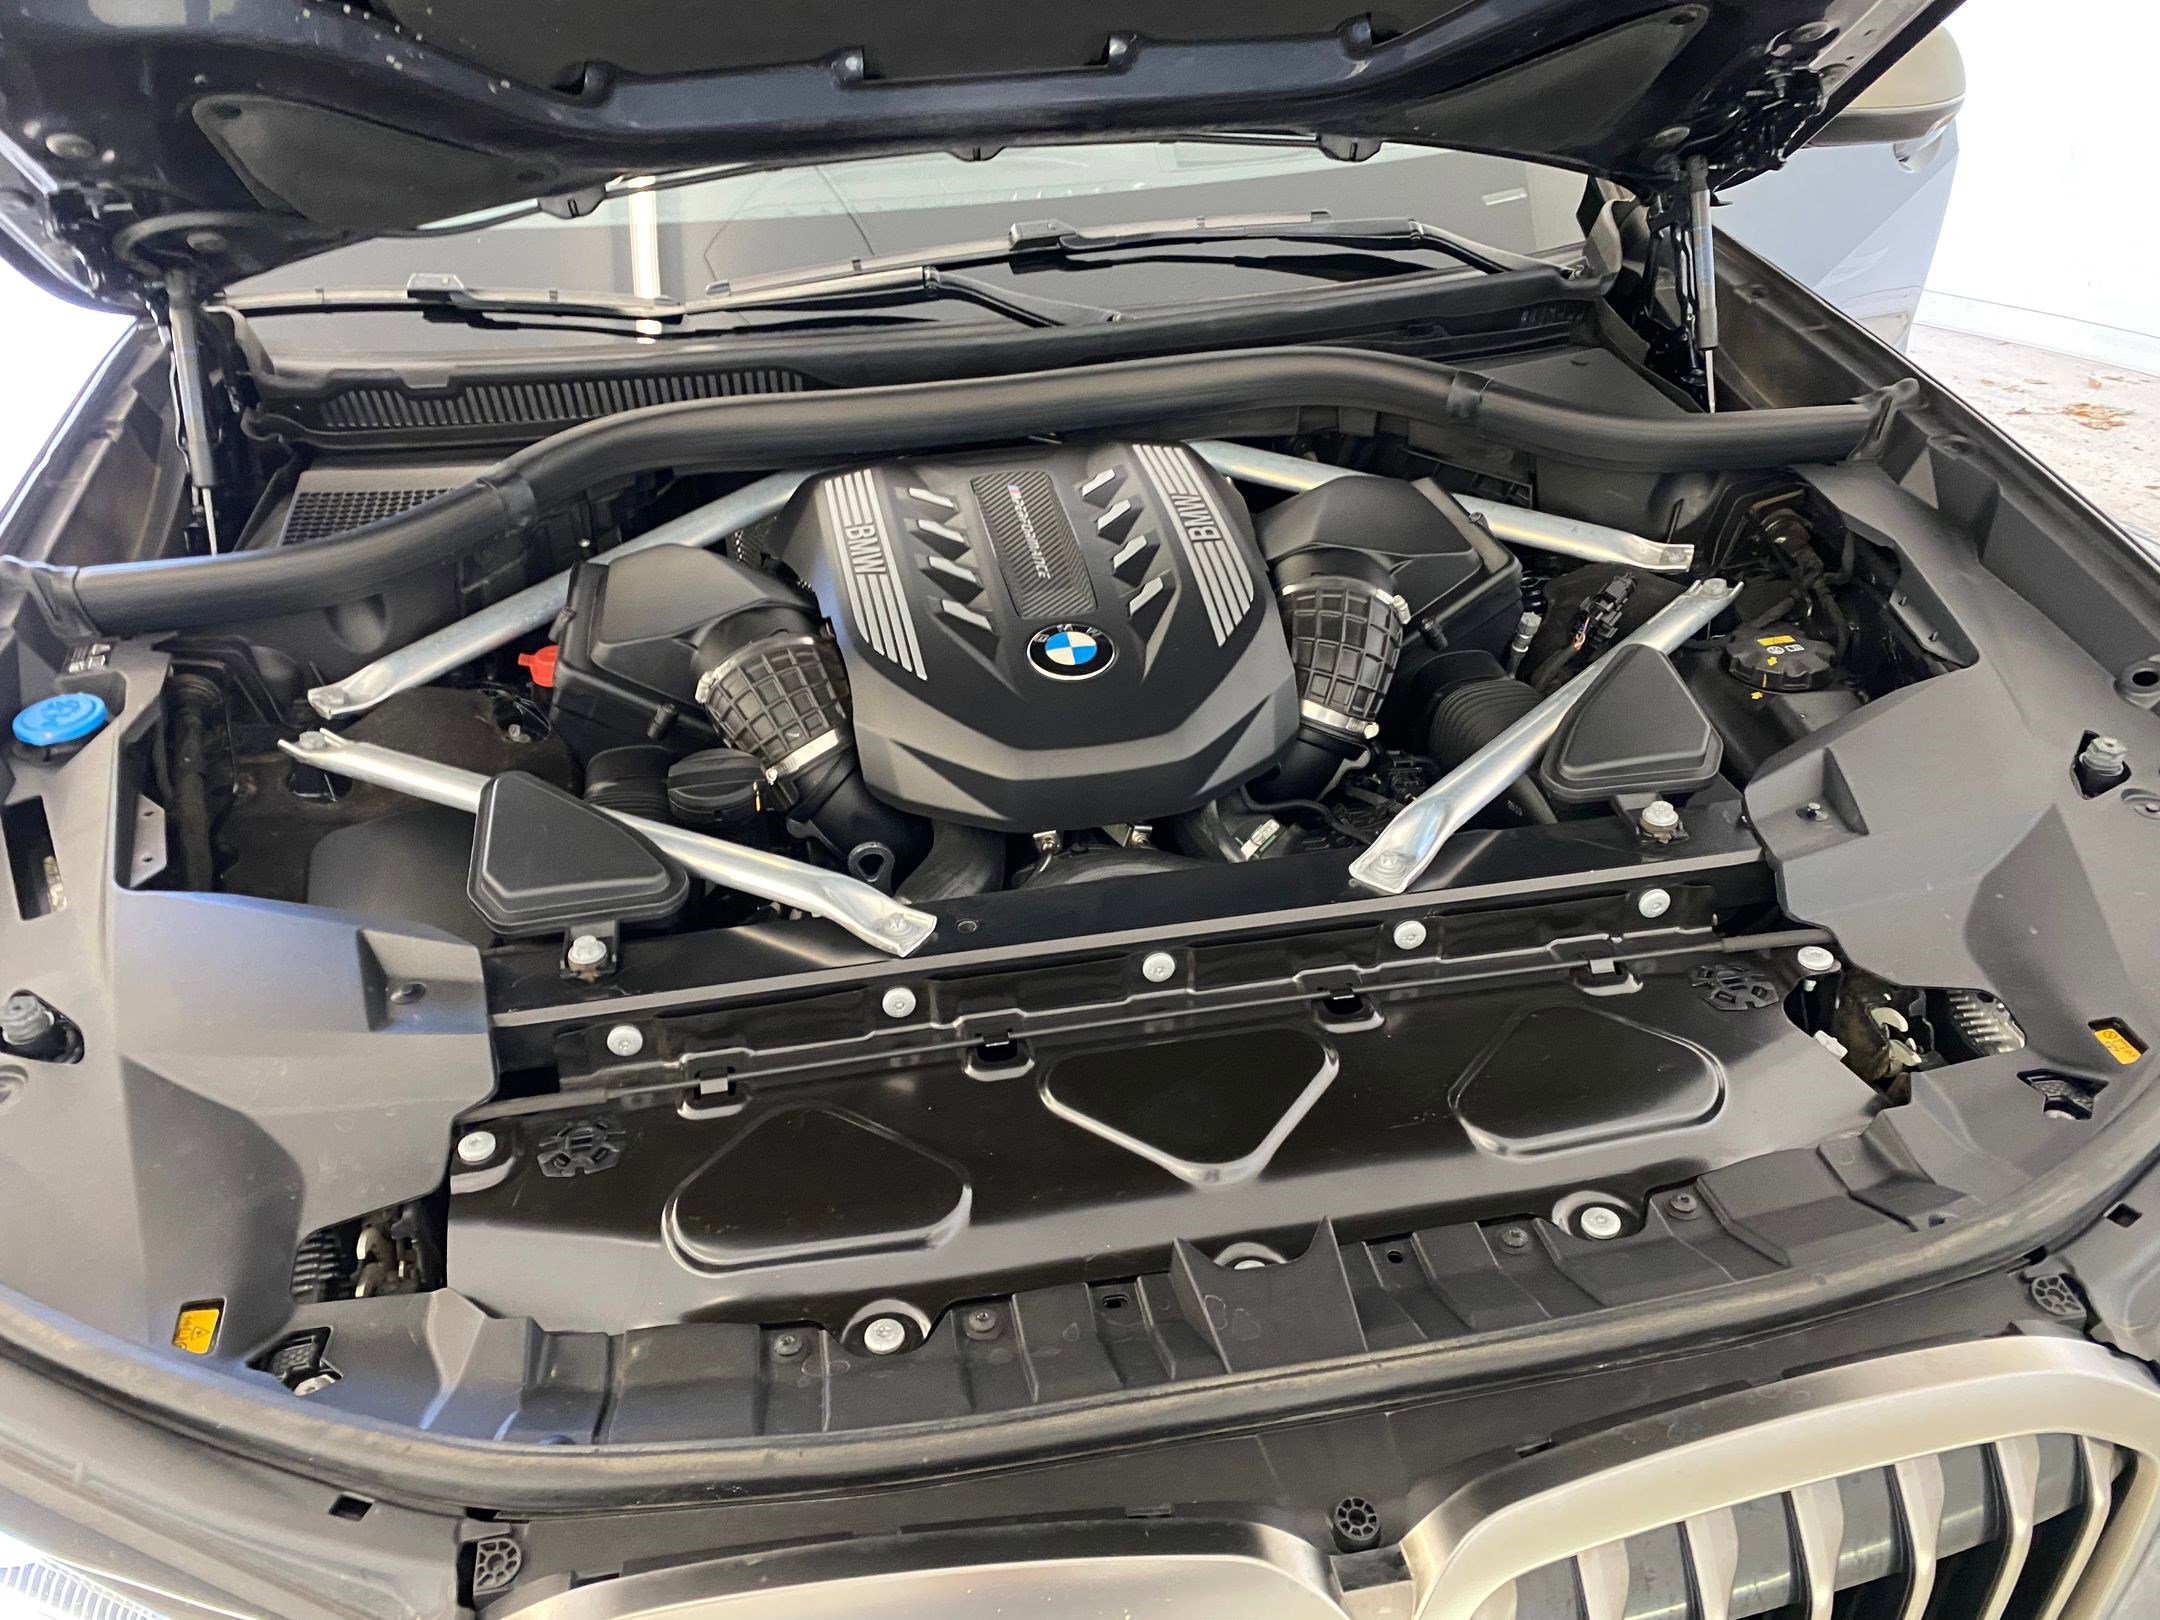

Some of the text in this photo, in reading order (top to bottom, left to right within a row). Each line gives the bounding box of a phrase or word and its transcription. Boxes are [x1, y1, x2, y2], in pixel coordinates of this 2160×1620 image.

[1171, 495, 1222, 541] BMW
[845, 524, 887, 574] BMW
[1033, 623, 1104, 643] BMW
